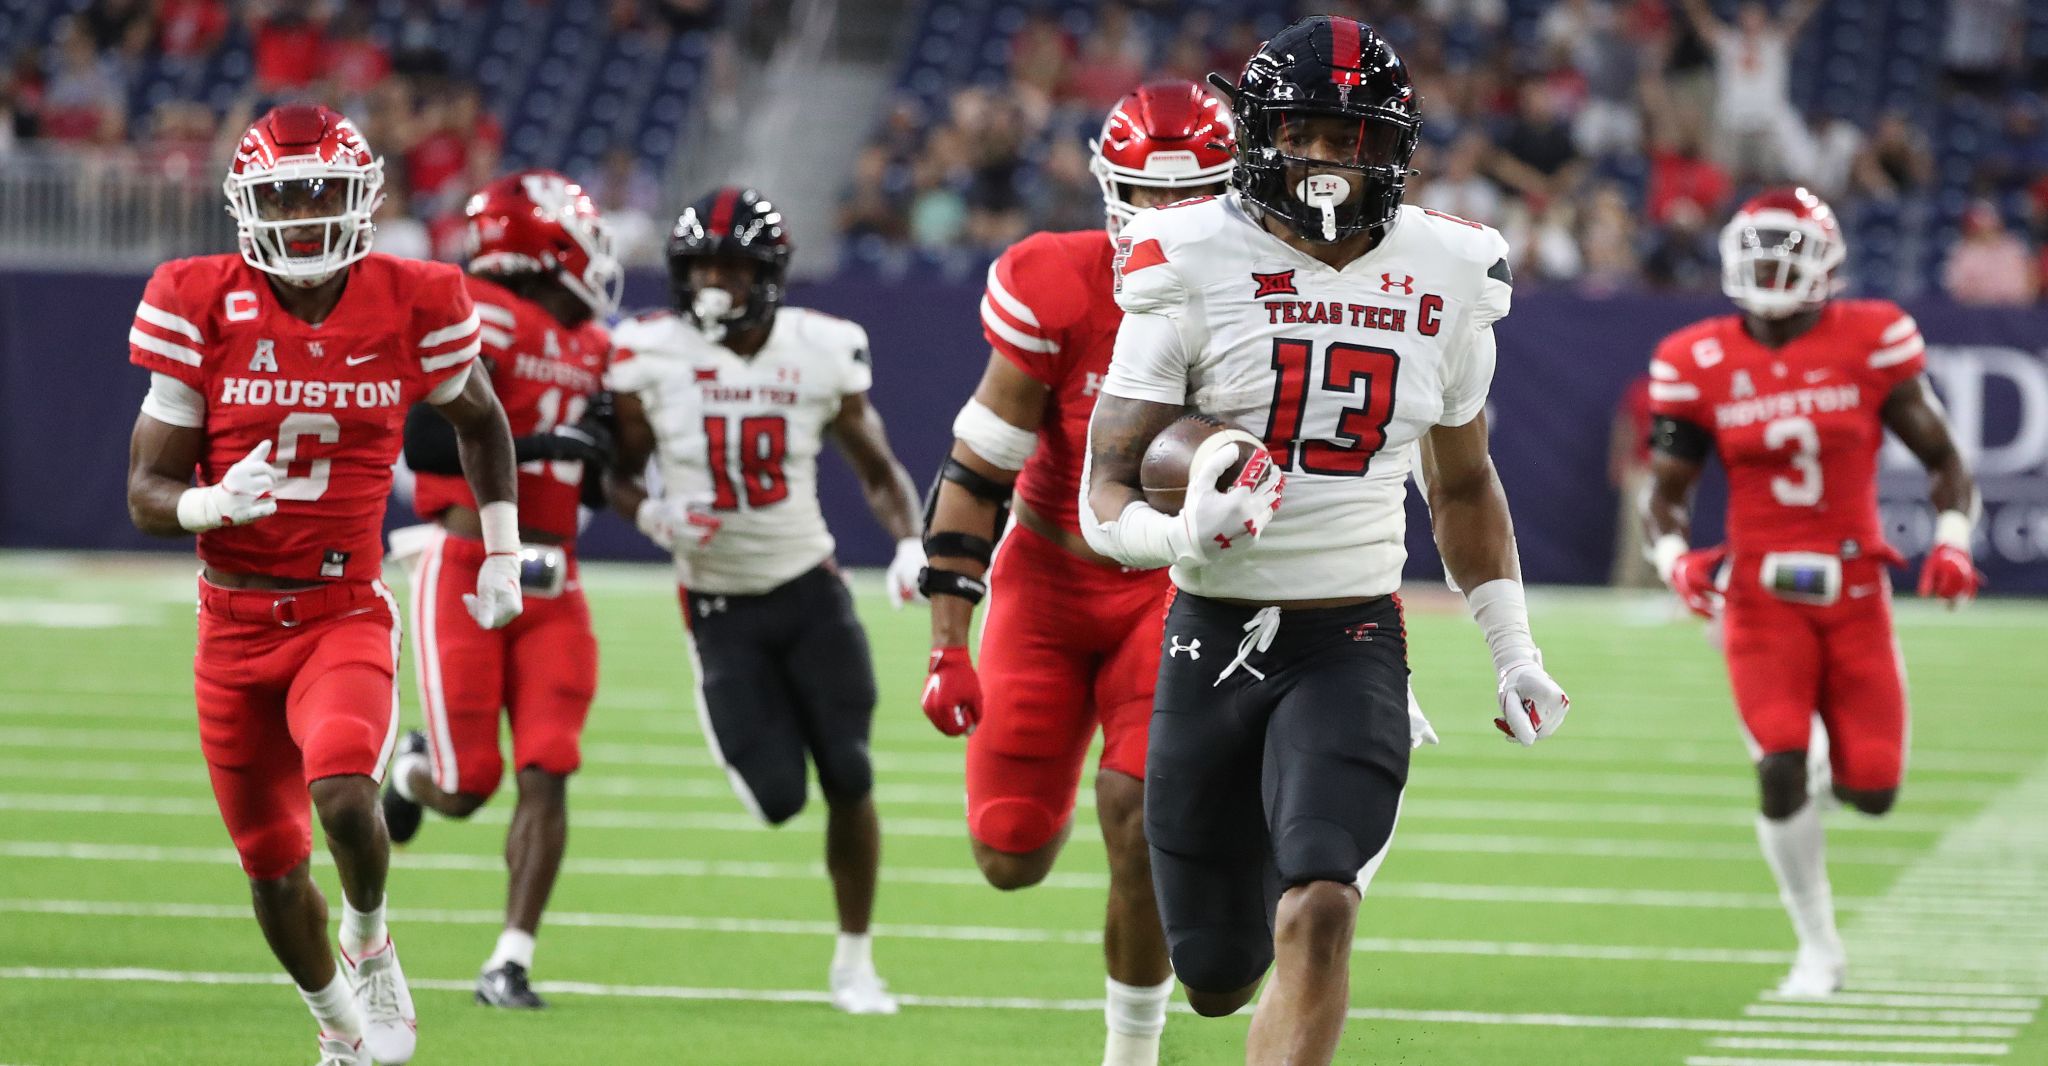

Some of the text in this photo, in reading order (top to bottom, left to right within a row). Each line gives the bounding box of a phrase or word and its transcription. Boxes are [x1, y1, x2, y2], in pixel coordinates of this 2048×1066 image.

[225, 290, 259, 322] C
[1265, 301, 1407, 332] TEXAS TECH
[1418, 293, 1444, 337] C
[220, 376, 402, 409] HOUSTON
[1264, 337, 1401, 478] 13
[703, 415, 789, 512] 18
[1763, 414, 1825, 507] 3
